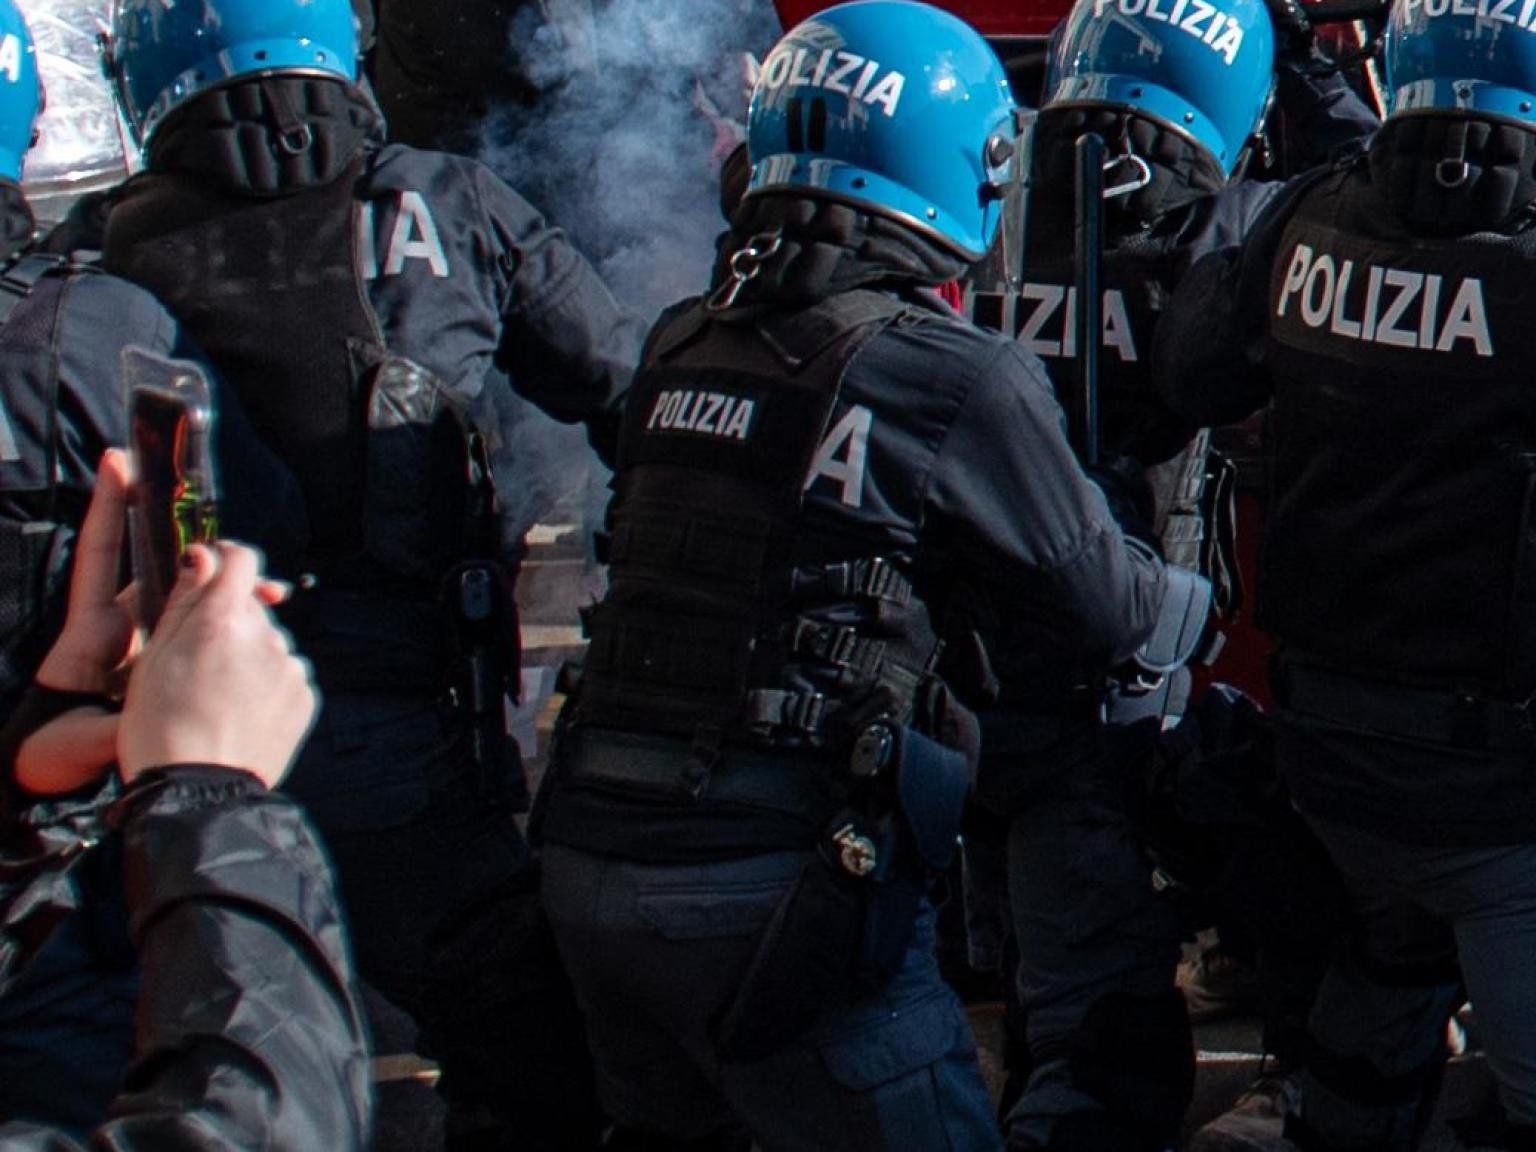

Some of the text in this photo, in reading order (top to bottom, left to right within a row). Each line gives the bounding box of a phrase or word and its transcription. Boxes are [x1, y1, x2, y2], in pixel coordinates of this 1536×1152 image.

[758, 47, 905, 117] OLIZIA
[1277, 244, 1493, 356] POLIZIA
[647, 389, 754, 439] POLIZIA
